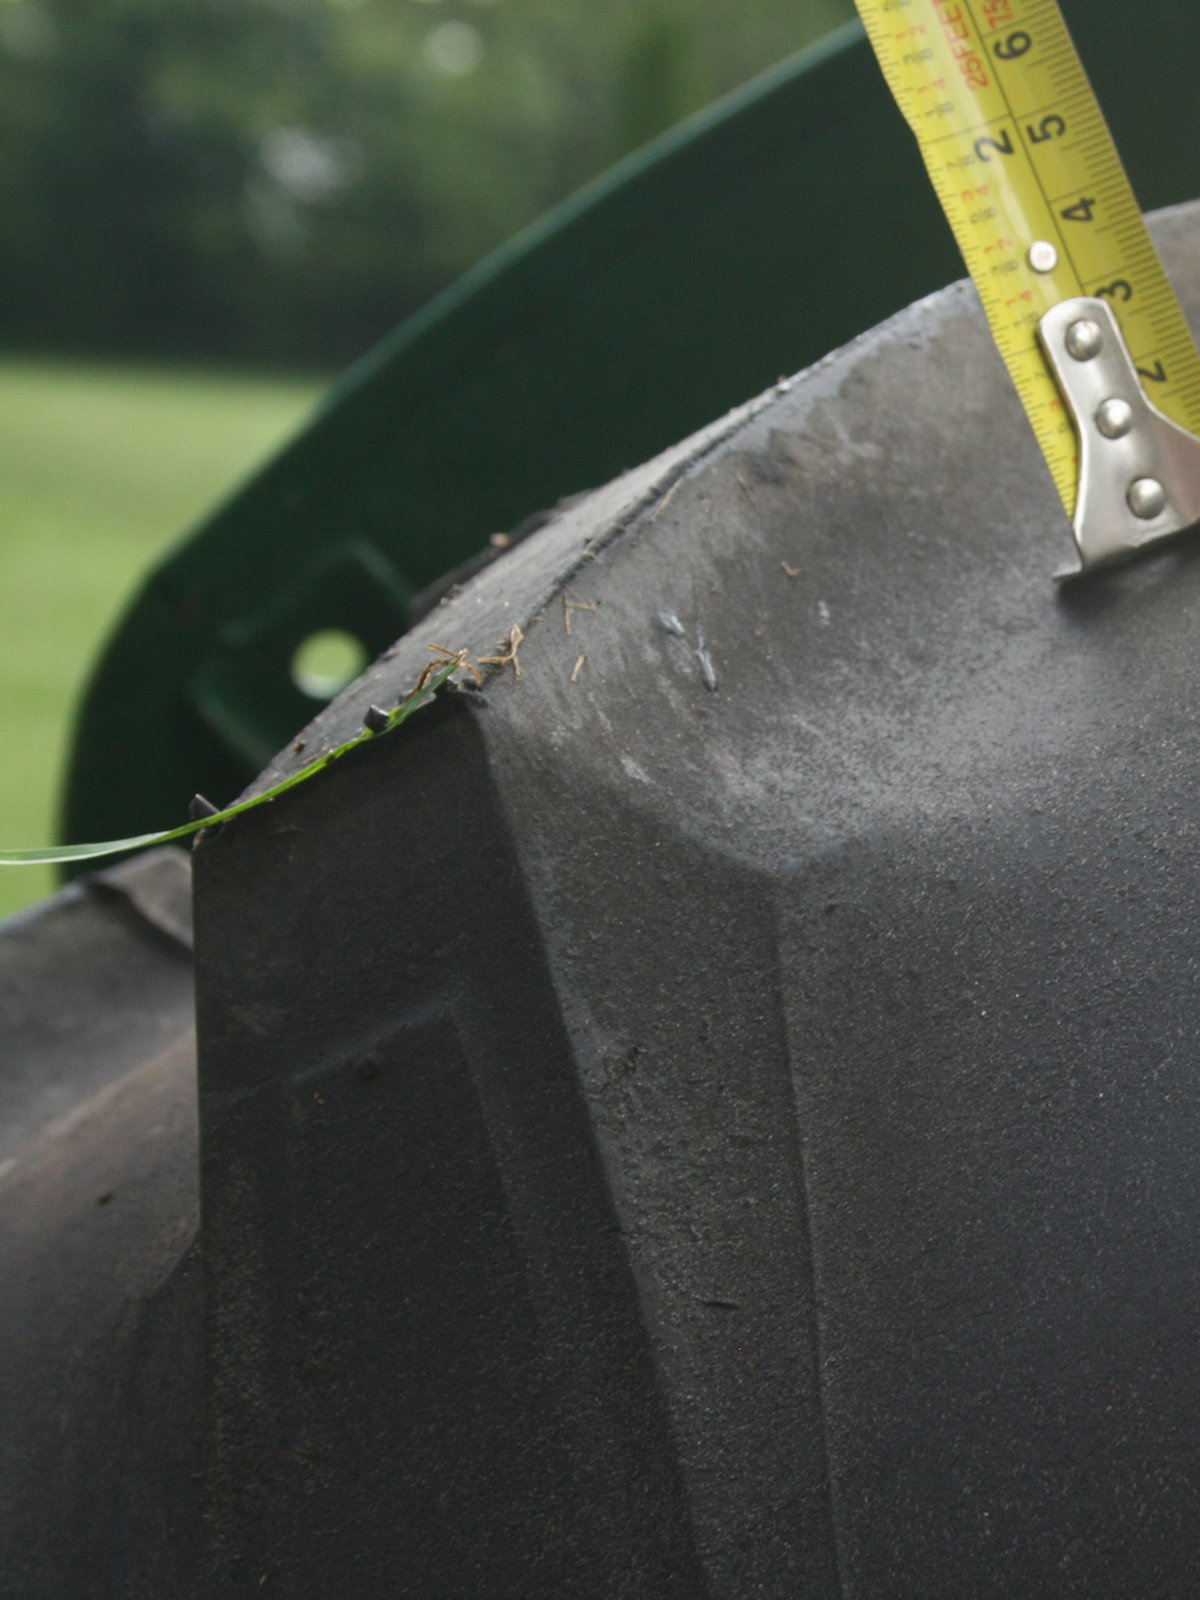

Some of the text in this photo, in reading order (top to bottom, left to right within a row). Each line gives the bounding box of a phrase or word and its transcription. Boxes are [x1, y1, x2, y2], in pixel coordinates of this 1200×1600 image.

[932, 0, 989, 91] 25FEE
[993, 31, 1032, 61] 6
[1027, 114, 1066, 144] 5
[974, 129, 1015, 162] 2
[1060, 197, 1096, 222] 4
[1095, 279, 1132, 302] 3
[1138, 360, 1167, 382] 2
